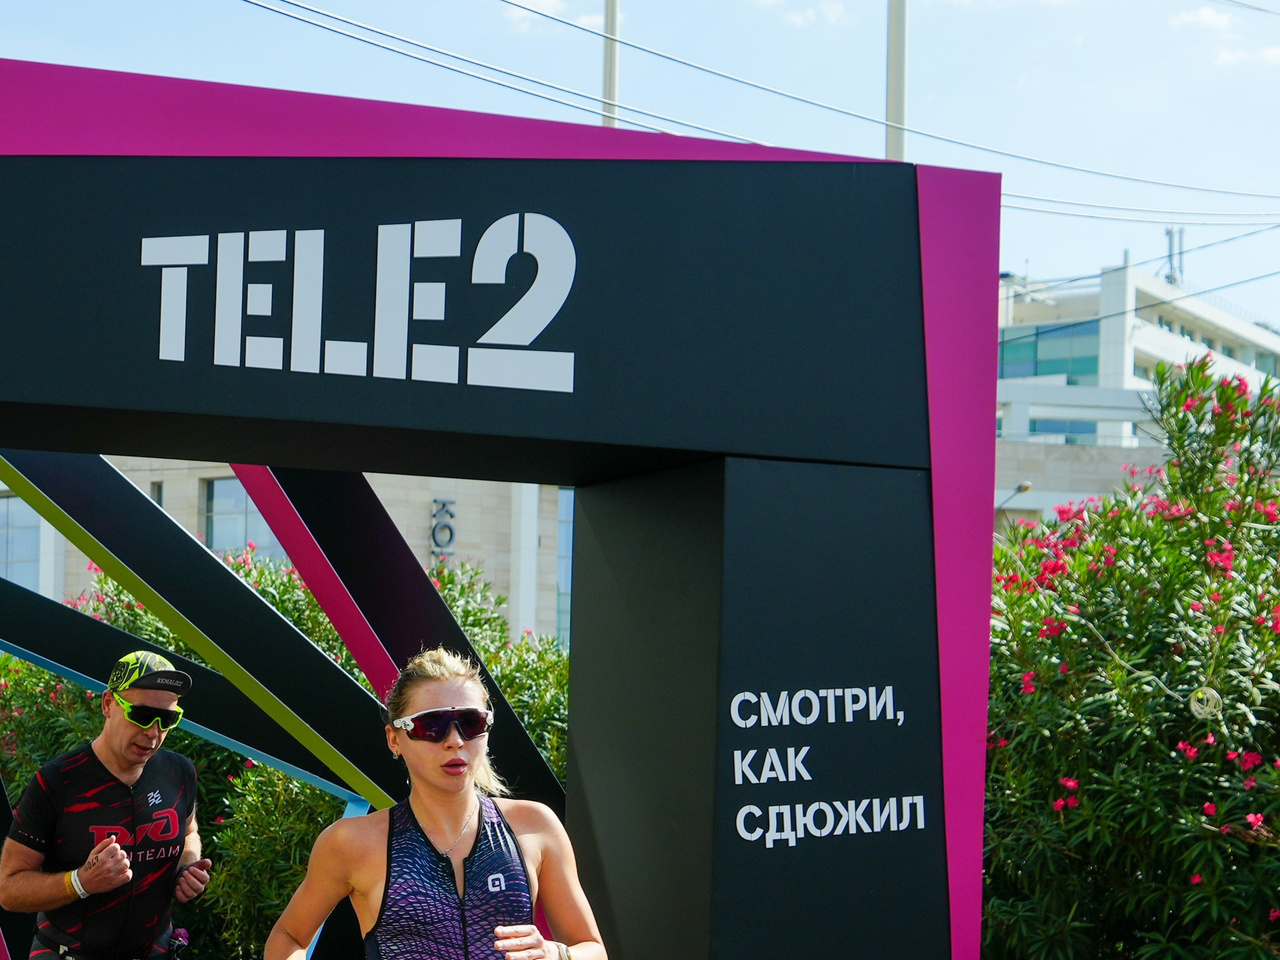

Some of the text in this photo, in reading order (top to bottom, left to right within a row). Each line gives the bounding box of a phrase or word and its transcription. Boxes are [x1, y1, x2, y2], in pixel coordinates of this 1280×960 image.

[141, 212, 577, 393] TELE2
[730, 685, 905, 728] СМОТРИ,
[733, 746, 813, 785] КАК
[736, 795, 926, 849] СДЮЖИЛ
